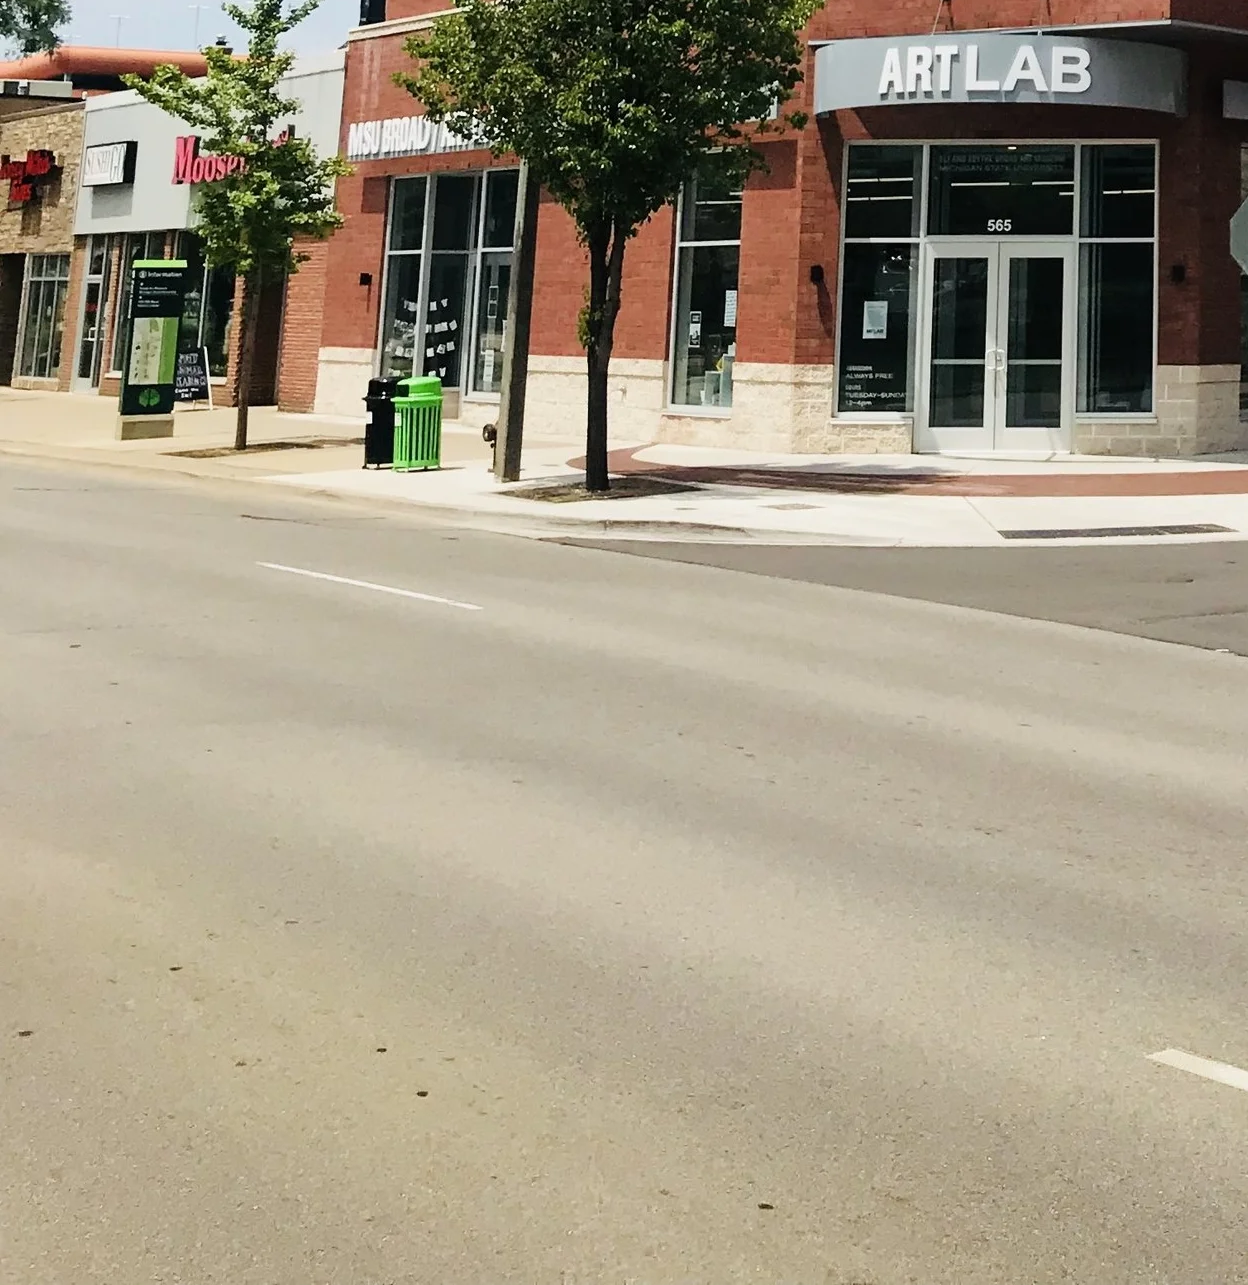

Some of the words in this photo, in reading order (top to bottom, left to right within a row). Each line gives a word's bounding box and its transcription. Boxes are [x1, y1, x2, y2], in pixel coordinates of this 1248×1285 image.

[348, 121, 381, 156] MSU
[381, 116, 430, 152] BROAD
[987, 219, 1012, 232] 565
